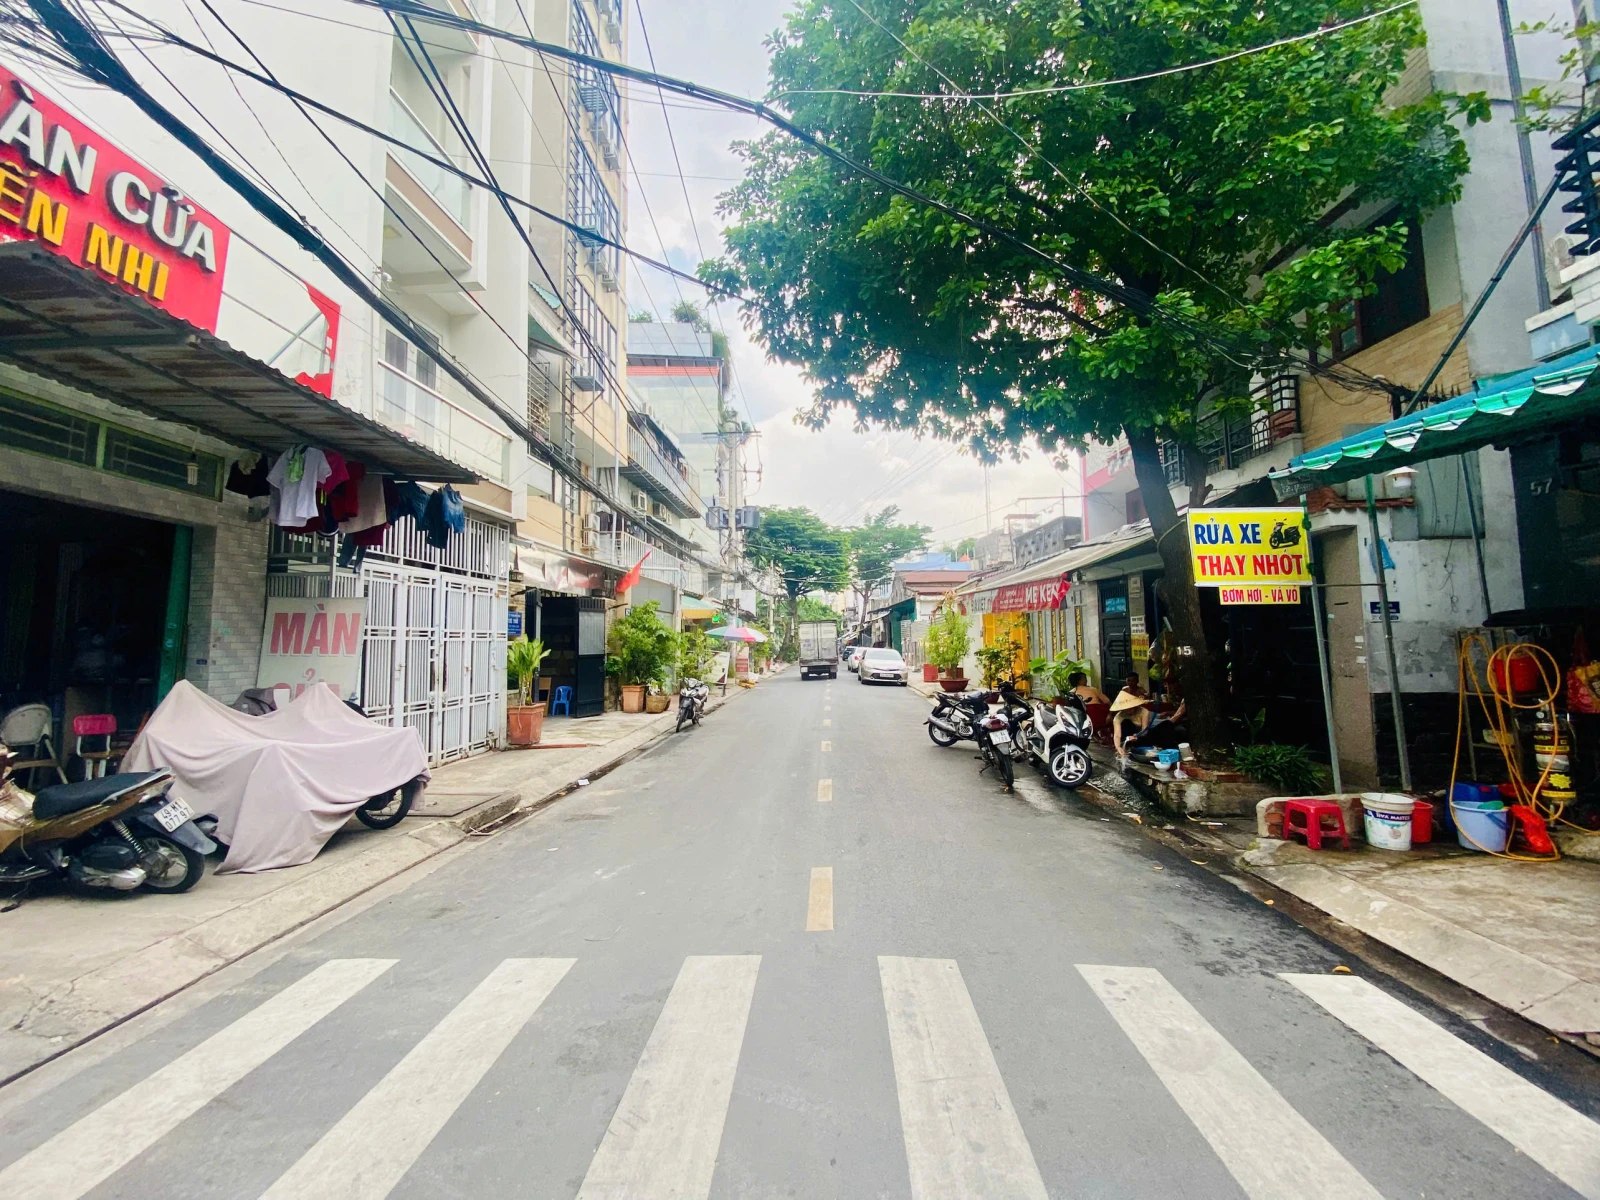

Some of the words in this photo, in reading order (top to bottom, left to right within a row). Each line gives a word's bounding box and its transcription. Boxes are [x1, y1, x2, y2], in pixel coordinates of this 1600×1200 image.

[0, 80, 97, 195] ÀN
[111, 184, 216, 272] CỬA
[86, 223, 169, 301] NHI
[1194, 517, 1234, 545] RỬA
[1239, 523, 1261, 544] XE
[1197, 554, 1246, 576] THAY
[269, 604, 361, 655] MÀN
[1177, 645, 1192, 656] 15
